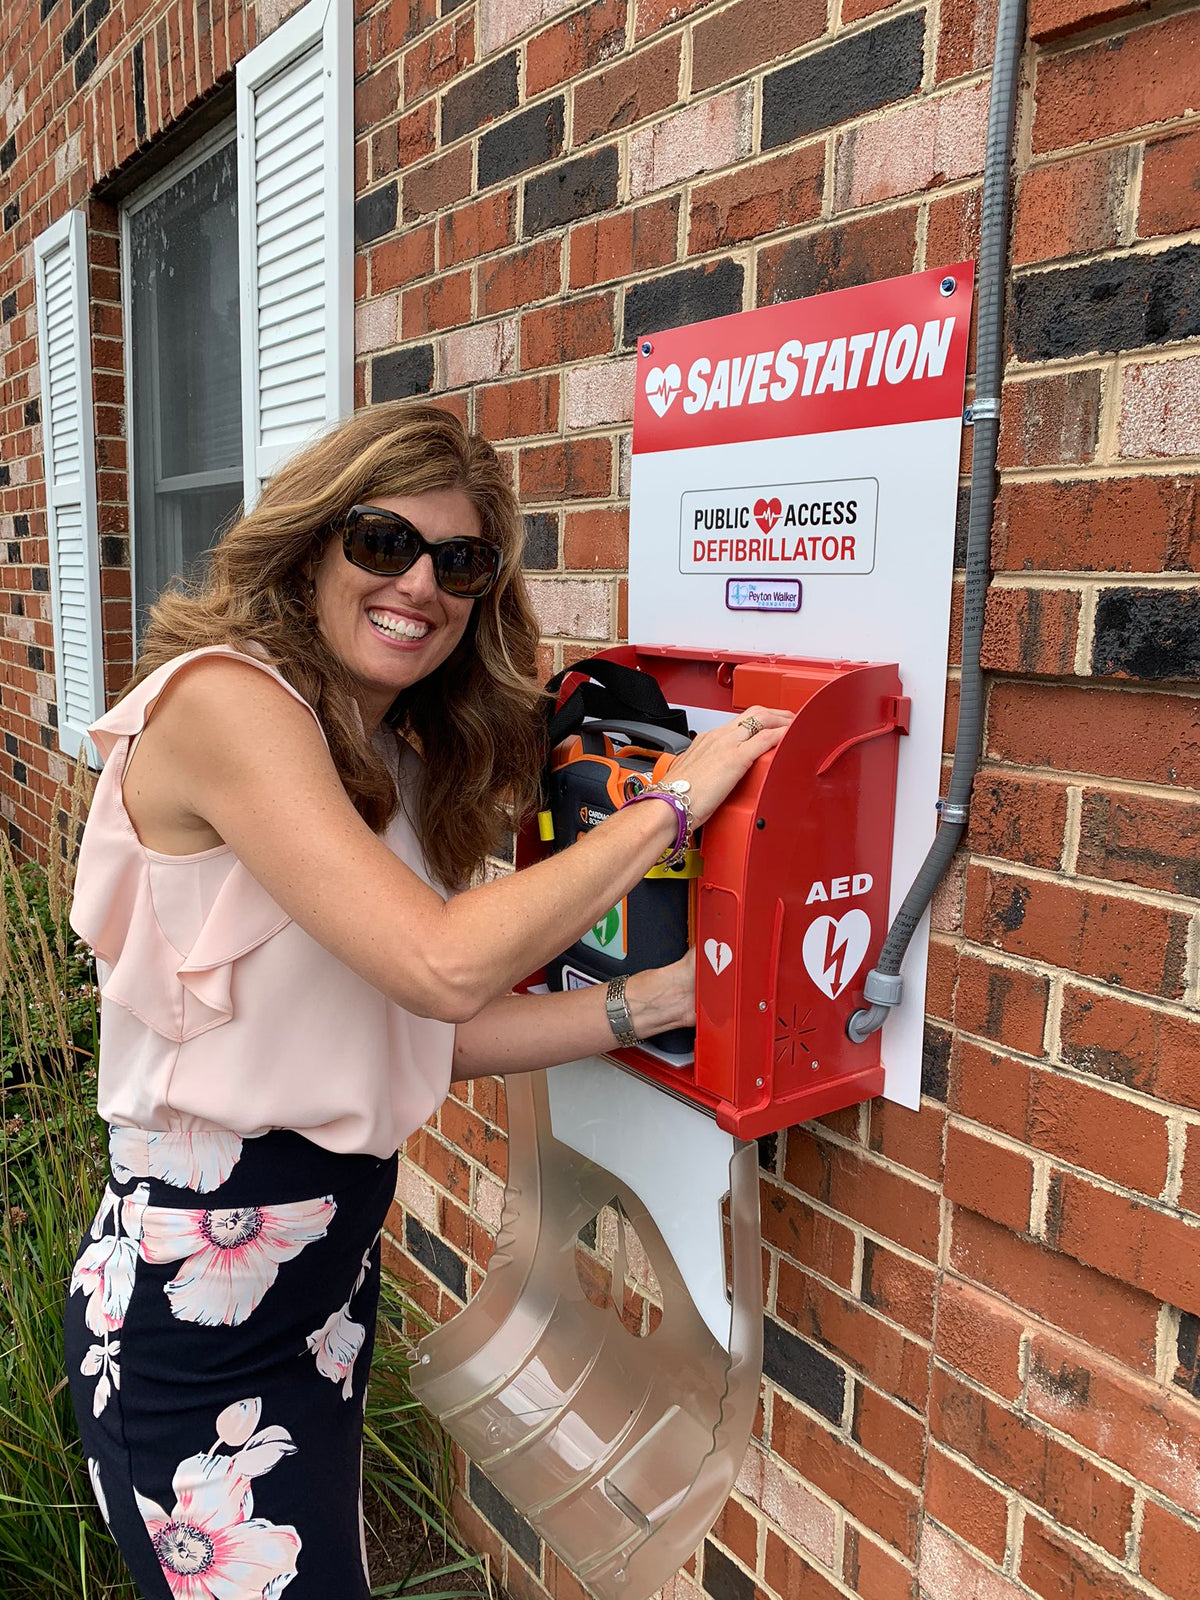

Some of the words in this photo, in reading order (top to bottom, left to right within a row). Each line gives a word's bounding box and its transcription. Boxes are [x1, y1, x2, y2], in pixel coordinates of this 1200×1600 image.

[694, 506, 750, 530] PUBLIC
[784, 500, 858, 527] ACCESS
[693, 535, 856, 562] DEFIBRILLATOR
[748, 590, 772, 603] Peyton
[773, 591, 797, 602] Walker
[804, 872, 874, 905] AED
